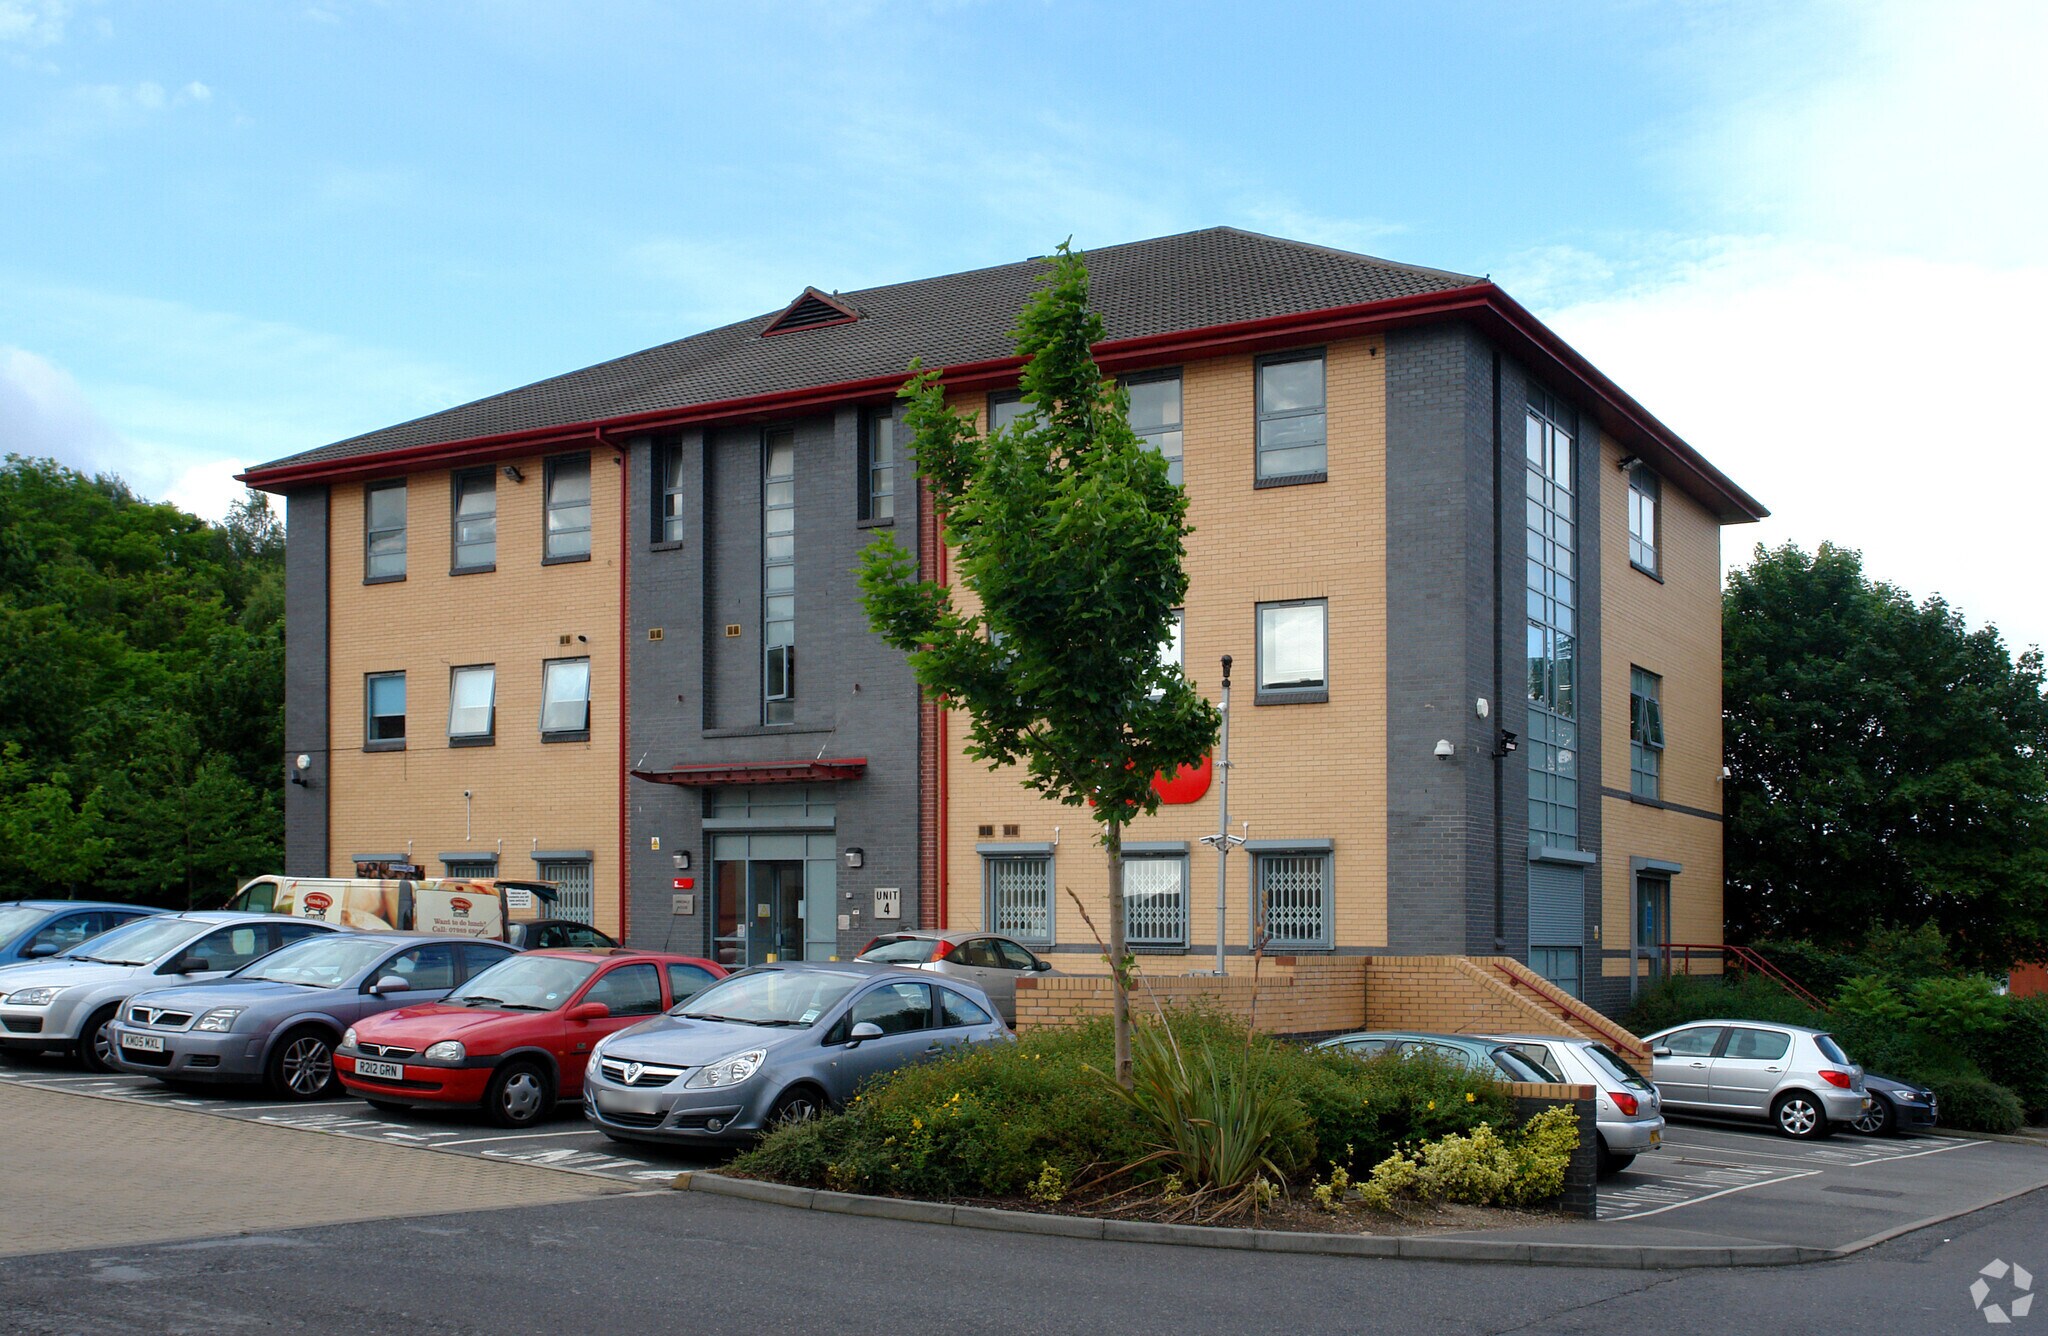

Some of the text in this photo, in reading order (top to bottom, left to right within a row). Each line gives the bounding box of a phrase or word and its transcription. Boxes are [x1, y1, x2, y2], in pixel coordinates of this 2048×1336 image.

[876, 890, 898, 901] UNIT
[883, 902, 890, 915] 4
[459, 918, 467, 926] do
[360, 1061, 397, 1077] R212 GRN
